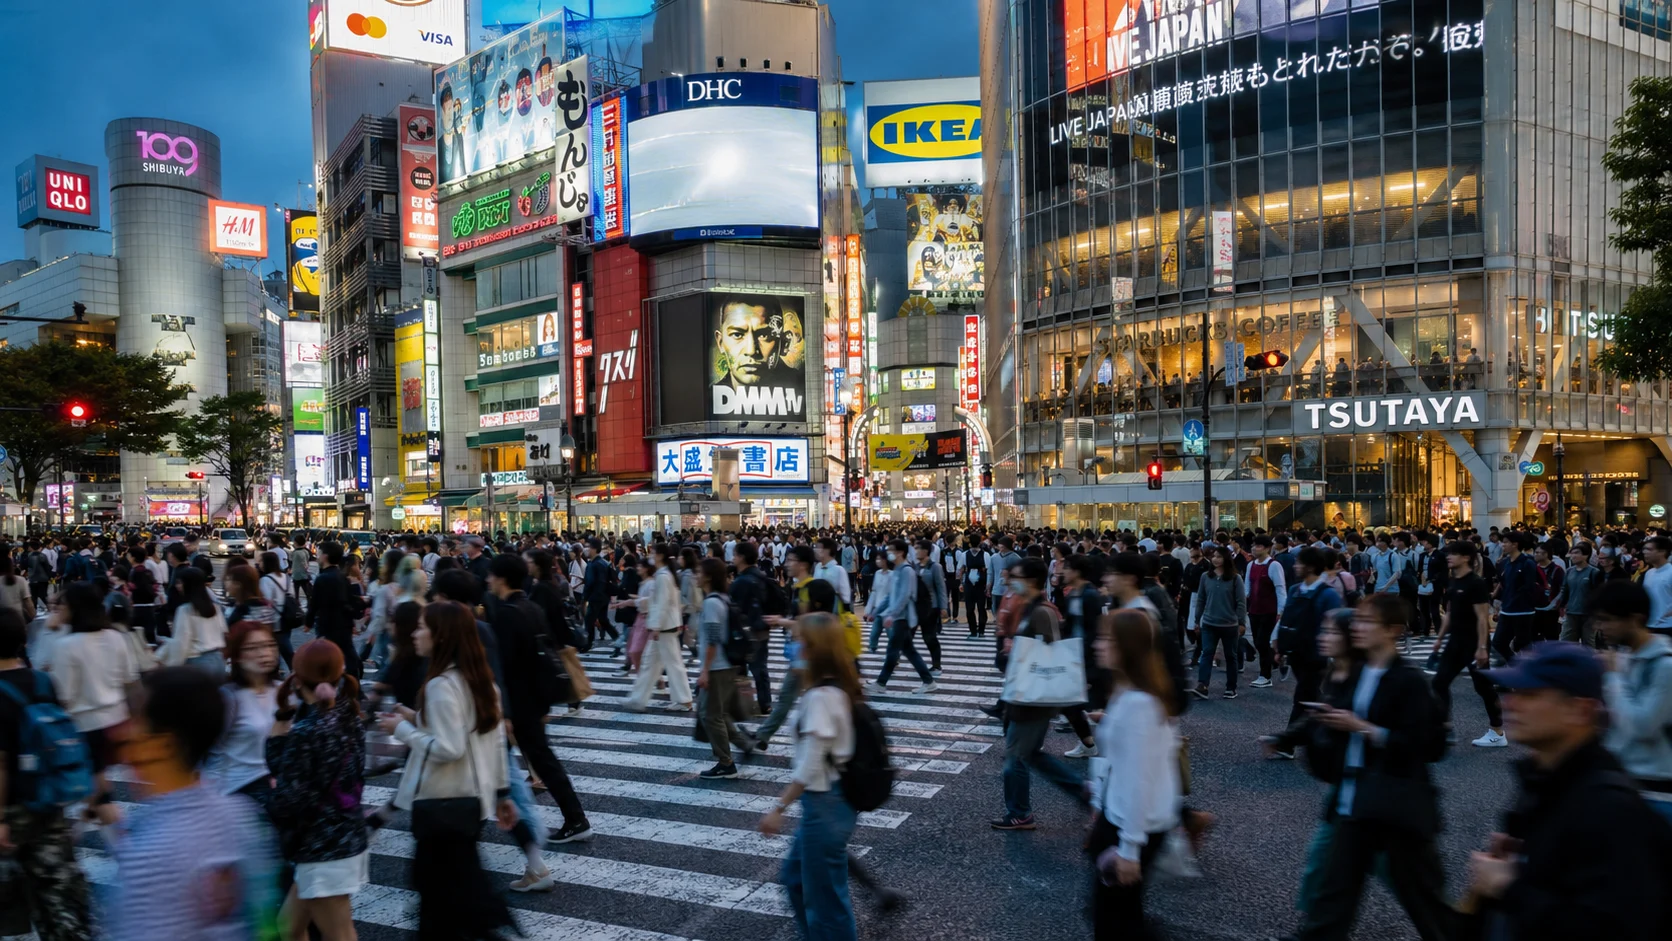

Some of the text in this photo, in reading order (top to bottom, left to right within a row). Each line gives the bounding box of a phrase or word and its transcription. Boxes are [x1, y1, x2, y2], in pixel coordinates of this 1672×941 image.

[419, 30, 453, 46] VISA
[1145, 3, 1224, 61] JAPAN
[687, 79, 742, 101] DHC
[1051, 116, 1083, 145] LIVE
[136, 131, 198, 177] 109
[49, 172, 82, 192] UNI
[143, 162, 185, 176] SHIBUYA
[50, 191, 87, 210] QLO
[1240, 309, 1340, 338] COFFEE
[713, 385, 787, 415] DMM
[1305, 396, 1480, 429] TSUTAYA
[662, 445, 799, 474] 大盛書店
